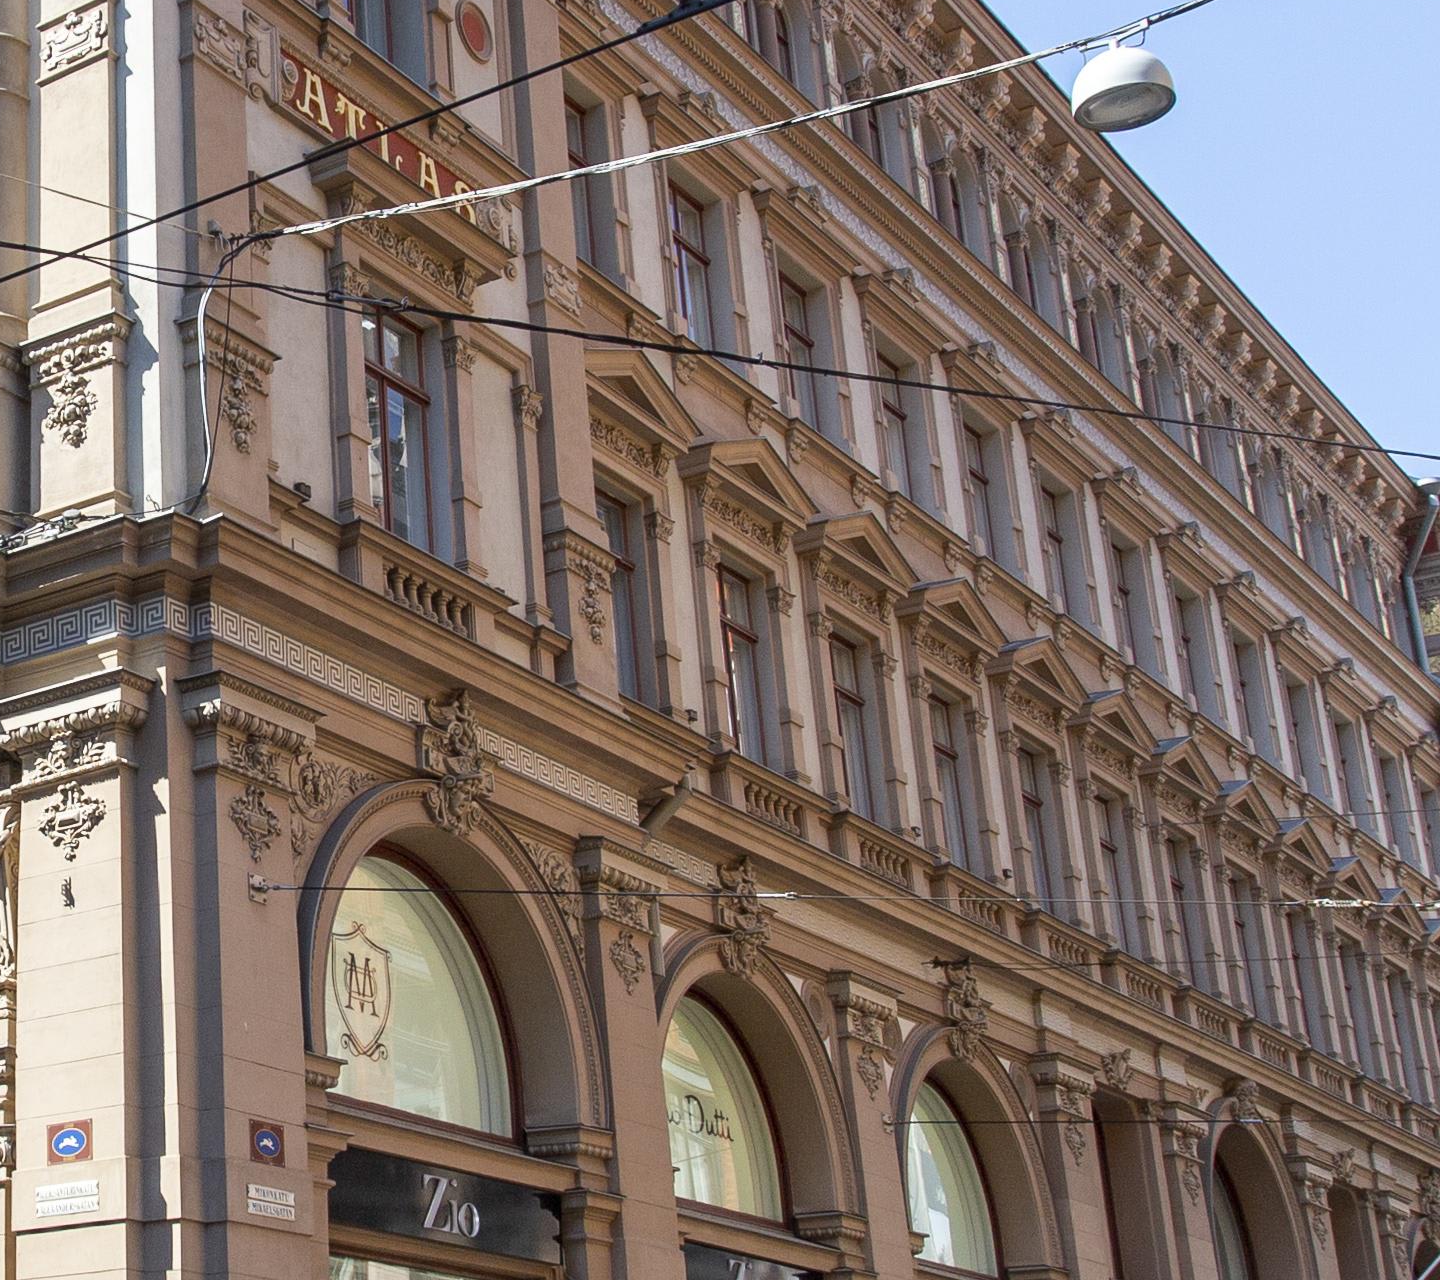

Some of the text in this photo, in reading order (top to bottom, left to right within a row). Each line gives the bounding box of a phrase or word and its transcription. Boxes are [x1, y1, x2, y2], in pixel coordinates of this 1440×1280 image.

[296, 67, 477, 224] ATLAS
[684, 1094, 734, 1143] Dutti
[422, 1173, 481, 1239] Zio
